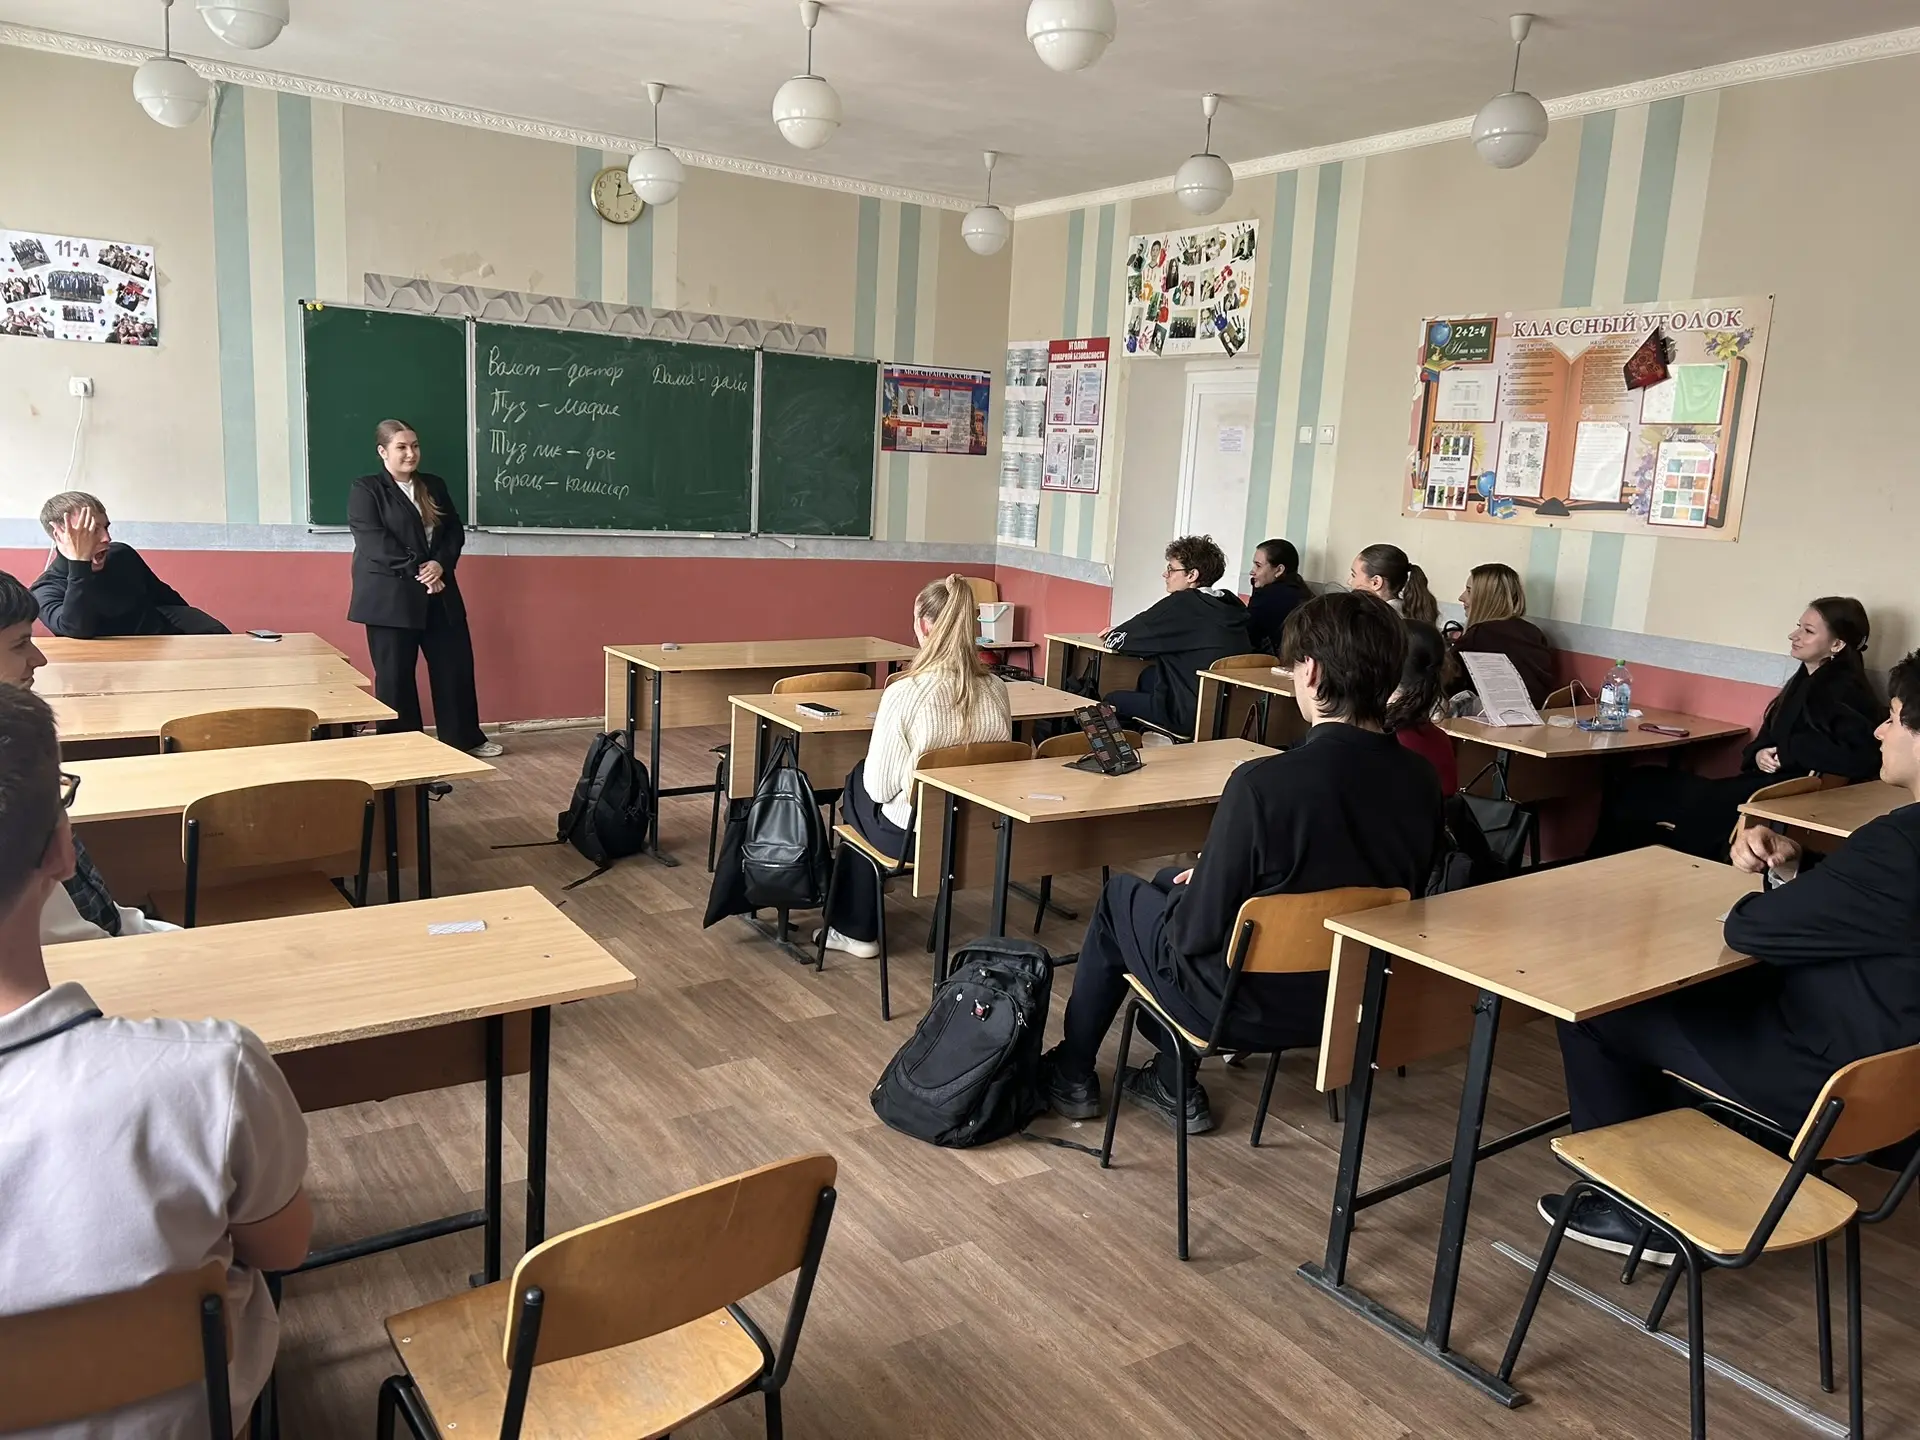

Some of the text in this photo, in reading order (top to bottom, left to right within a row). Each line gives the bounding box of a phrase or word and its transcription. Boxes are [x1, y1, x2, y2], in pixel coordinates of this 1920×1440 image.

[1455, 325, 1487, 338] 2+2=4
[1513, 310, 1742, 337] КЛАССНЫЙ УГОЛОК
[1069, 340, 1088, 350] УГОЛОК
[488, 345, 540, 376] Валет
[567, 363, 624, 387] доктор
[652, 363, 695, 386] Дама
[711, 373, 748, 396] дама
[491, 388, 528, 423] Туз
[490, 429, 528, 465] Туз
[533, 444, 563, 458] пик
[586, 446, 616, 469] док
[494, 467, 542, 494] Король
[565, 477, 630, 500] комиссар
